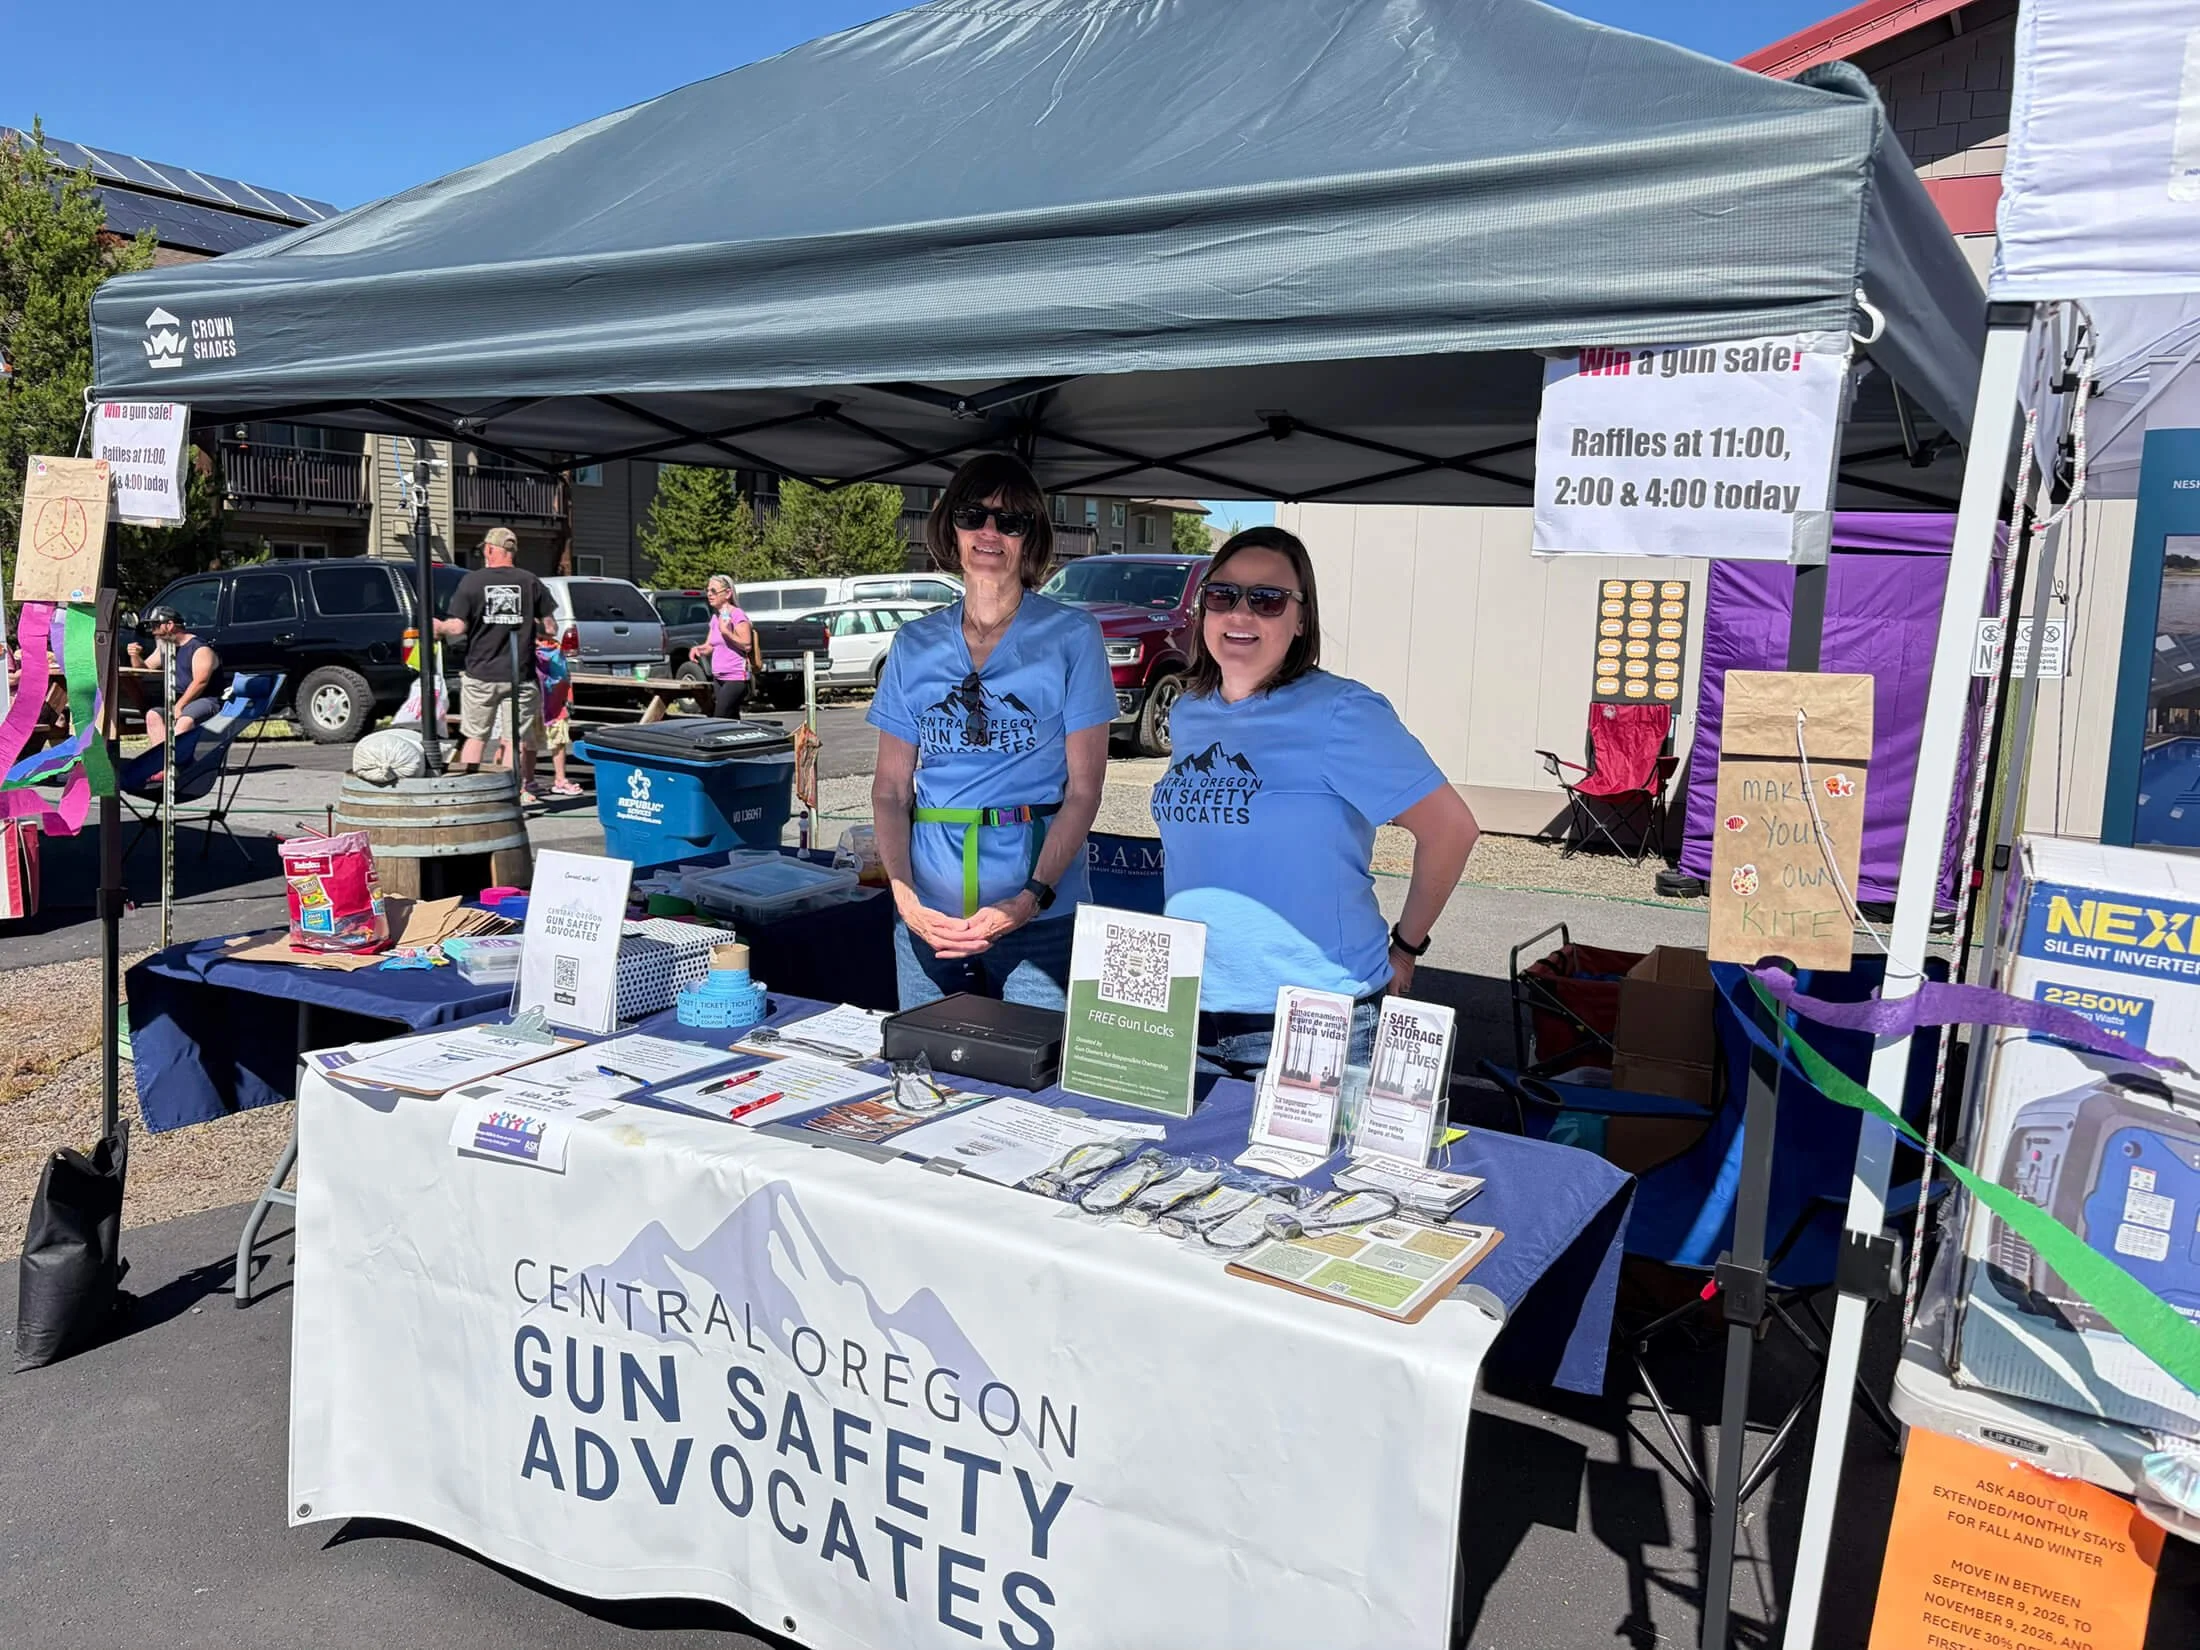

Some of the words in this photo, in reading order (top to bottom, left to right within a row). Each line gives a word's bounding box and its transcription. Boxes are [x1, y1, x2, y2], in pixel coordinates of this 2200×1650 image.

[191, 316, 234, 339] CROWN
[193, 340, 237, 359] SHADES
[1578, 347, 1631, 377] Win
[1638, 350, 1655, 375] a
[1660, 348, 1717, 378] gun
[1724, 341, 1804, 373] safe!
[104, 401, 121, 419] Win
[122, 406, 128, 419] a
[129, 405, 147, 421] gun
[148, 404, 173, 420] safe!
[1571, 427, 1667, 458] Raffles
[1673, 428, 1702, 458] at
[1709, 426, 1791, 461] 11:00,
[102, 446, 132, 462] Raffles
[132, 447, 142, 463] at
[143, 447, 166, 465] 11:00,
[124, 474, 142, 490] 4:00
[144, 475, 169, 494] today
[1554, 475, 1613, 507] 2:00
[1621, 482, 1639, 507] &
[1645, 478, 1706, 508] 4:00
[1714, 480, 1801, 514] today
[960, 724, 1035, 747] SFETY
[1200, 777, 1263, 791] OREGON
[1742, 779, 1819, 802] MAKE
[1152, 788, 1174, 805] UN
[1179, 789, 1257, 806] SAFETY
[1152, 806, 1250, 825] DVOCATES
[1760, 814, 1836, 849] YOUR
[1783, 864, 1837, 889] OWN
[546, 914, 564, 926] GUN
[567, 918, 601, 932] SAFETY
[1742, 901, 1841, 939] KITE
[545, 925, 598, 942] ADVOCATES
[2044, 939, 2111, 961] SILENT
[701, 1001, 723, 1009] TICKET
[731, 999, 752, 1009] TICKET
[2044, 987, 2144, 1017] 2250W
[1088, 1009, 1115, 1026] FREE
[1118, 1015, 1141, 1032] Gun
[1143, 1020, 1175, 1038] Locks
[1389, 1012, 1418, 1029] SAFE
[1290, 1024, 1317, 1036] salva
[1321, 1028, 1347, 1041] vidas
[1391, 1024, 1443, 1046] STORAGE
[1385, 1036, 1421, 1055] SAVES
[1406, 1051, 1440, 1070] LIVES
[514, 1257, 766, 1355] CENTRAL
[791, 1325, 1079, 1459] OREGON
[514, 1324, 682, 1424] GUN
[726, 1365, 1074, 1560] SAFETY
[1976, 1479, 2004, 1496] ASK
[2006, 1489, 2056, 1511] ABOUT
[2057, 1503, 2089, 1521] OUR
[1933, 1485, 2080, 1539] EXTENDED/MONTHLY
[2082, 1531, 2126, 1553] STAYS
[520, 1414, 1057, 1650] ADVOCATES
[1947, 1510, 1977, 1528] FOR
[1978, 1521, 2010, 1540] FALL
[2013, 1532, 2044, 1550] AND
[2047, 1541, 2103, 1567] WINTER
[1951, 1559, 1992, 1581] MOVE
[1994, 1573, 2010, 1587] IN
[2012, 1578, 2081, 1609] BETWEEN
[1932, 1573, 2014, 1609] SEPTEMBER
[2016, 1601, 2029, 1616] 9,
[2032, 1606, 2069, 1628] 2026,
[2073, 1619, 2092, 1633] TO
[1922, 1611, 1982, 1640] RECEIVE
[1983, 1632, 2013, 1650] 30%
[1924, 1591, 2002, 1626] NOVEMBER
[2005, 1618, 2017, 1633] 9,
[2020, 1623, 2057, 1645] 2026,
[2061, 1637, 2093, 1650] AND
[1927, 1634, 1968, 1650] FIRST
